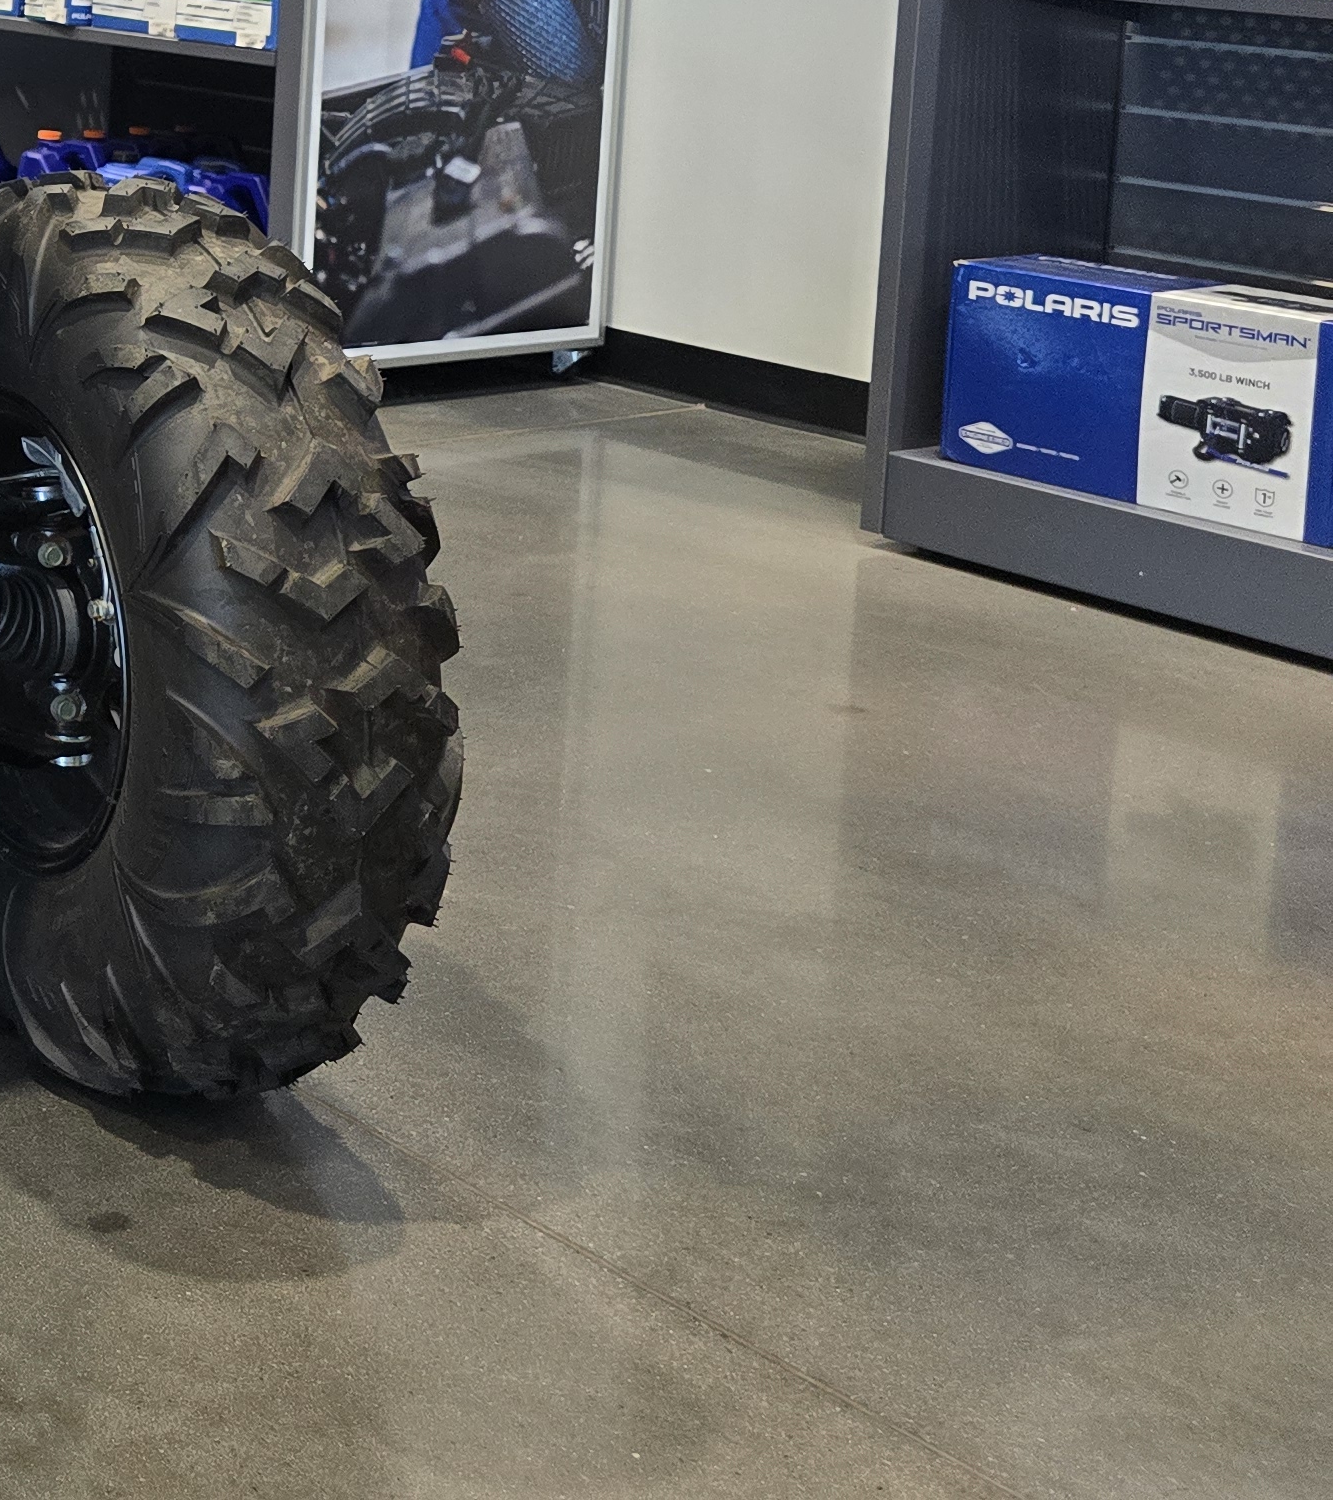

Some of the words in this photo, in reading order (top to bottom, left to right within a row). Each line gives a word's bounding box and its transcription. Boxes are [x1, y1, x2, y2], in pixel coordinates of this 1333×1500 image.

[967, 279, 1140, 329] POLARIS
[1156, 304, 1203, 318] POLARIS
[1155, 313, 1308, 349] SPORTSMAN
[1188, 367, 1217, 381] 3,500
[1219, 373, 1233, 383] LB
[1235, 376, 1271, 391] WINCH
